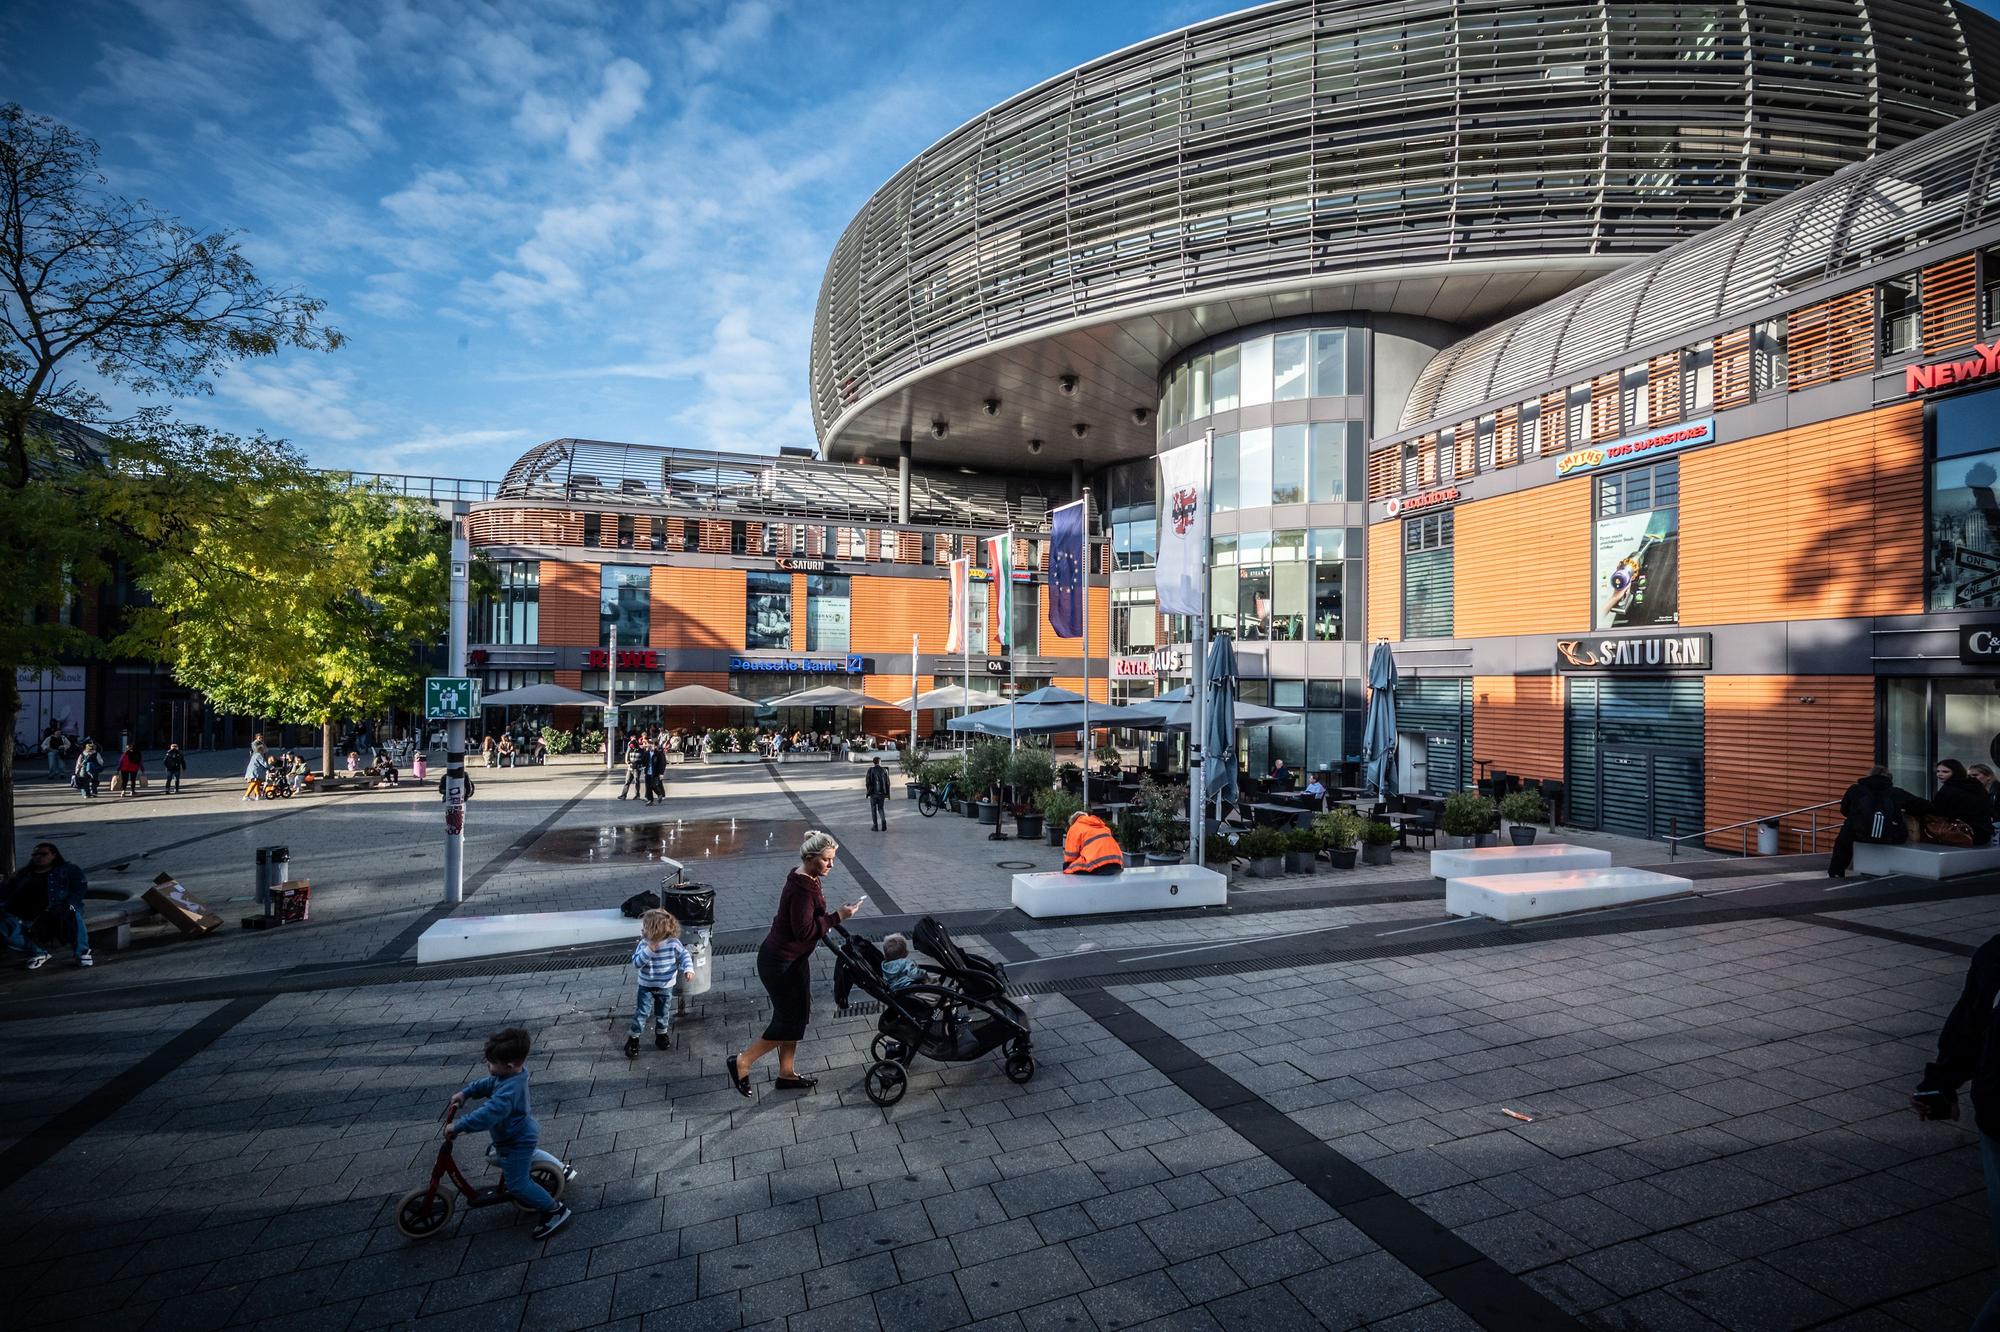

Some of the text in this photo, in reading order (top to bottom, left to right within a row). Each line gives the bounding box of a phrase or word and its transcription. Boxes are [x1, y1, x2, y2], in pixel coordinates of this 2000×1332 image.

[1557, 425, 1708, 472] SMYTHS TOYS SUPERSTORES
[793, 560, 825, 571] SATURN
[1966, 555, 1987, 567] ONE
[1964, 583, 1982, 597] ONE
[1969, 631, 2000, 654] C&
[1600, 638, 1701, 666] SATURN
[730, 658, 837, 672] Deutsche Bank
